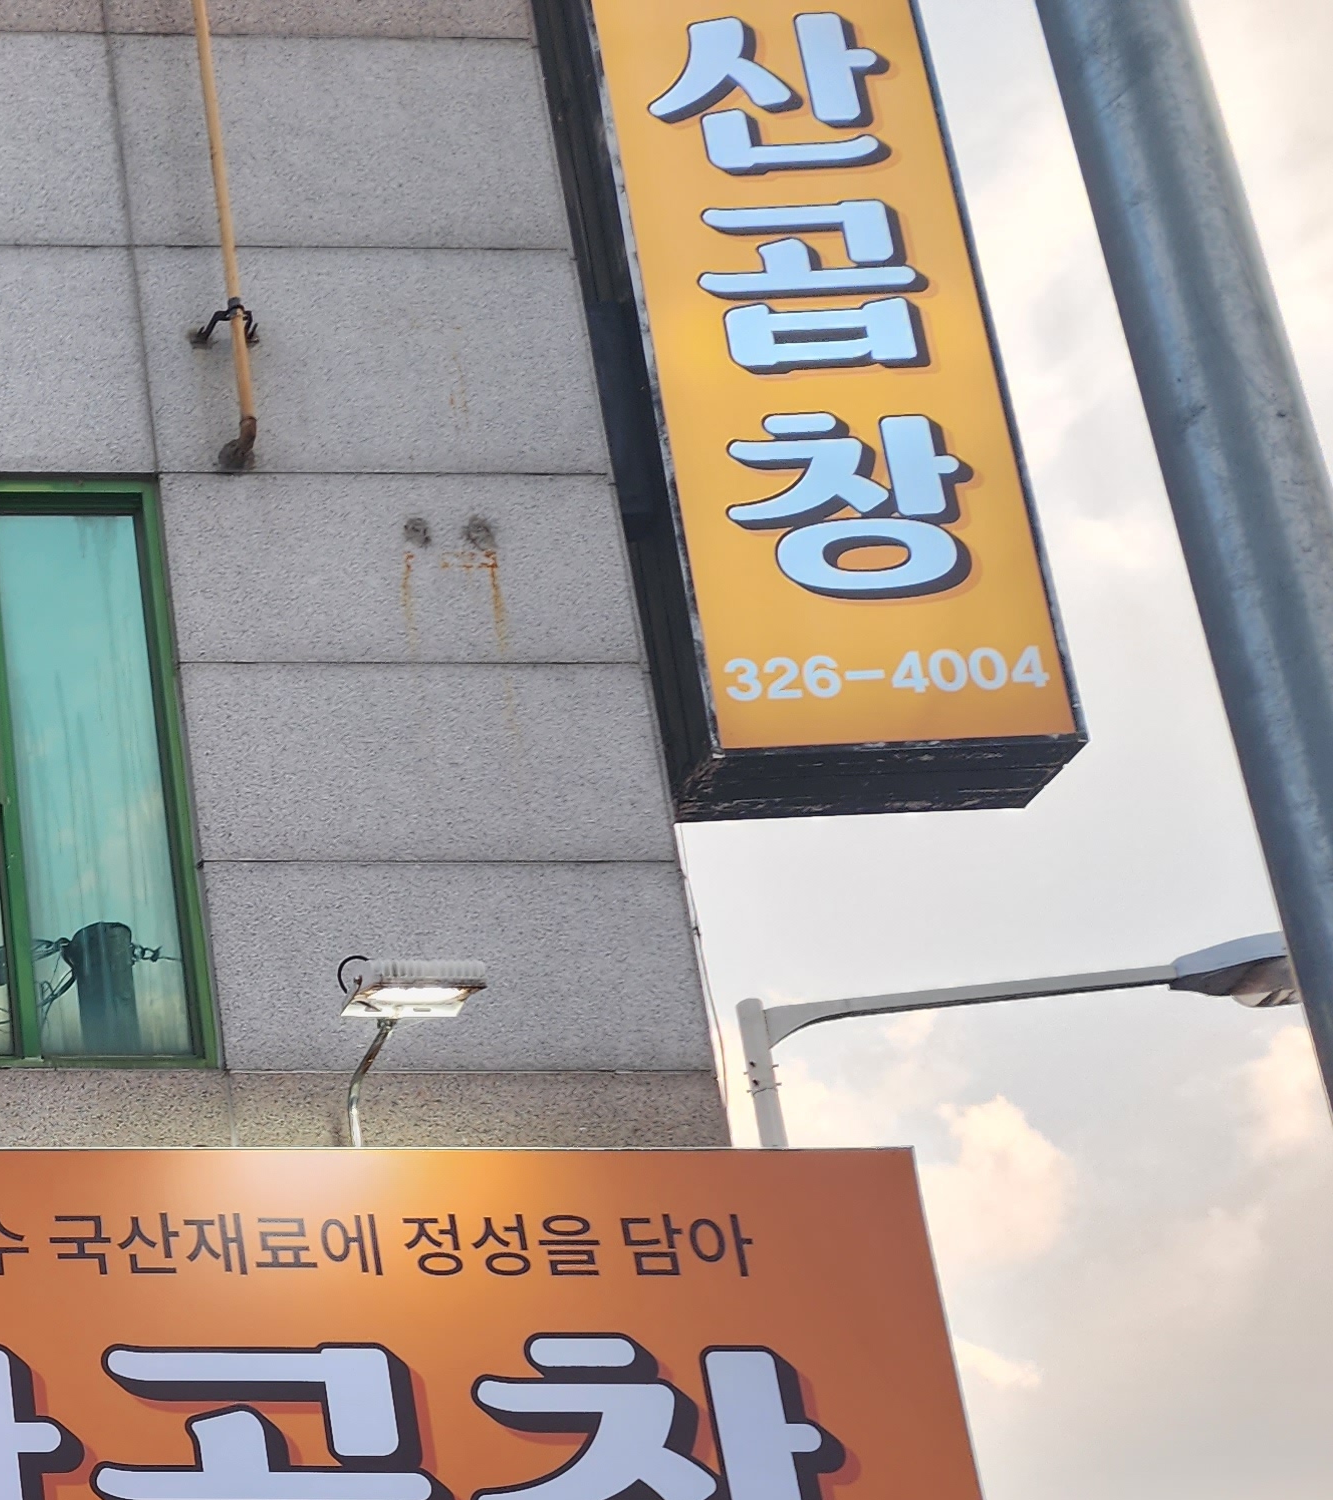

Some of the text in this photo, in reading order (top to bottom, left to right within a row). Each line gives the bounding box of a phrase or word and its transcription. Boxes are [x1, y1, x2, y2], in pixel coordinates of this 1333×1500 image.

[647, 10, 974, 599] 산곱창
[724, 645, 1050, 703] 326-4004
[48, 1212, 385, 1277] 국산재료에
[402, 1212, 602, 1278] 정성을
[622, 1212, 754, 1279] 담아
